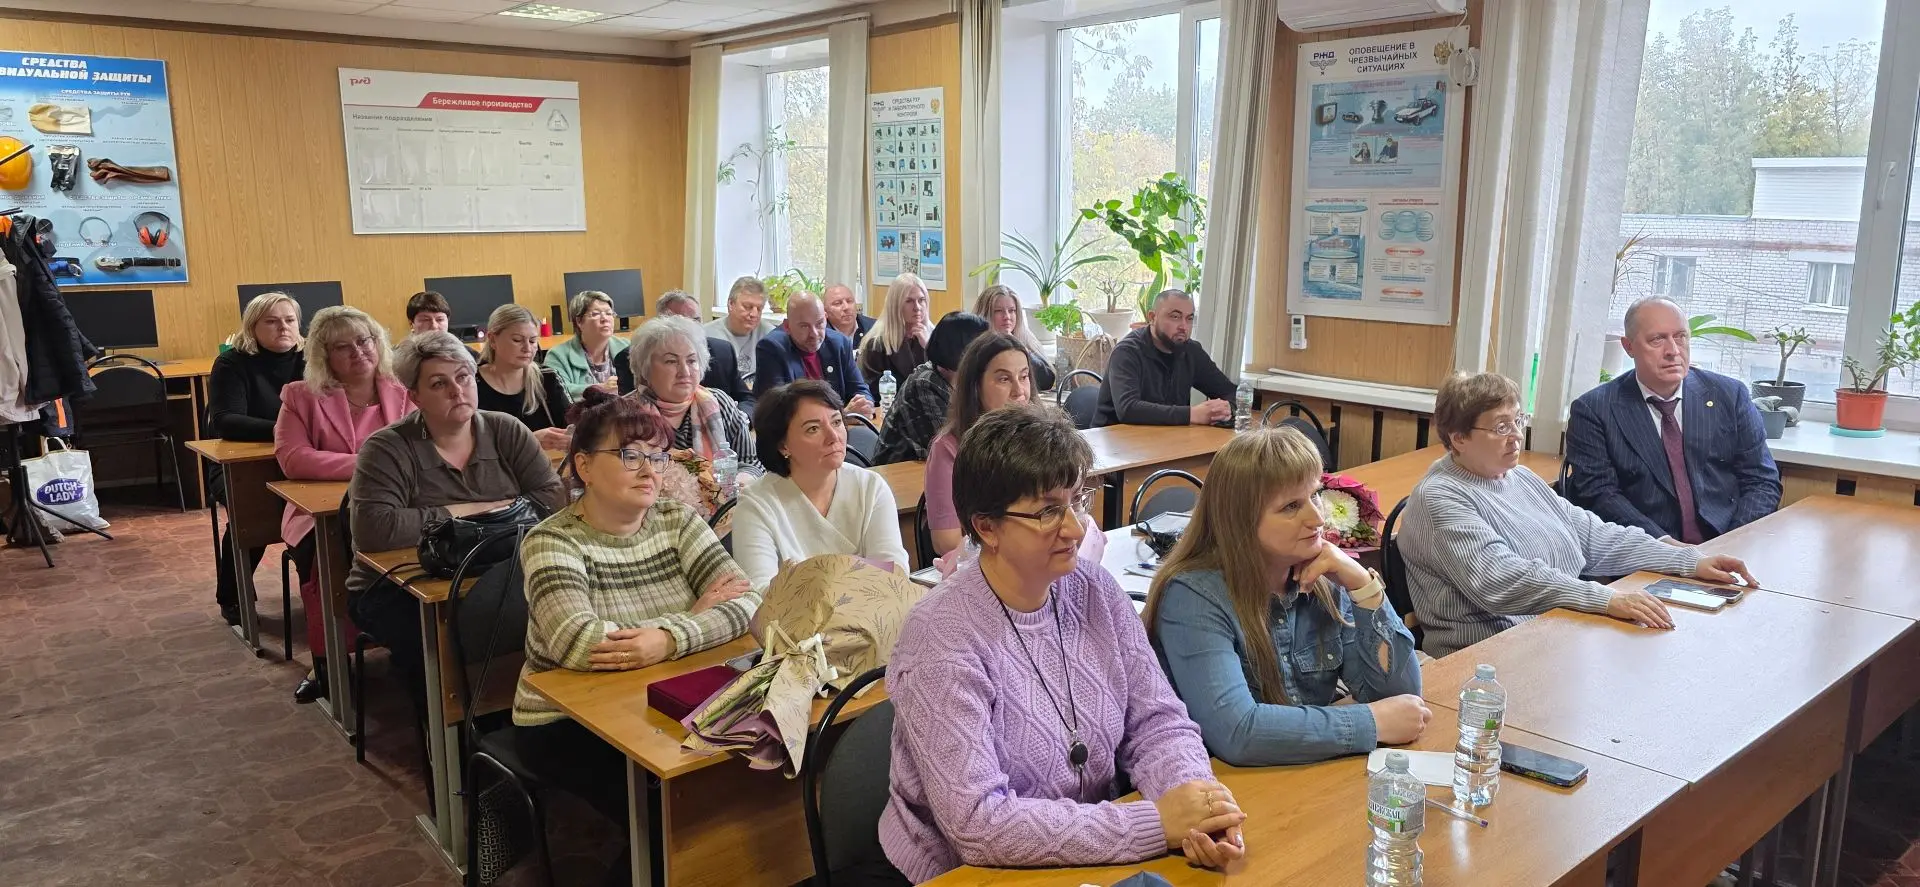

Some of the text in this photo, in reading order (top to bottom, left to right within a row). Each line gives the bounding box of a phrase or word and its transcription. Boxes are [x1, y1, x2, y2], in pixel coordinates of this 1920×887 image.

[1314, 51, 1335, 59] РЖД
[1348, 43, 1407, 55] ОПОВЕЩЕНИЕ
[22, 57, 88, 69] СРЕДСТВА
[1348, 51, 1418, 64] ЧРЕЗВЫЧАЙНЫХ
[1357, 62, 1405, 74] СИТУАЦИЯХ
[92, 71, 152, 84] ЗАЩИТЫ
[432, 97, 533, 109] Бережливое производство
[44, 481, 78, 494] DUTCH
[49, 490, 76, 503] LADY
